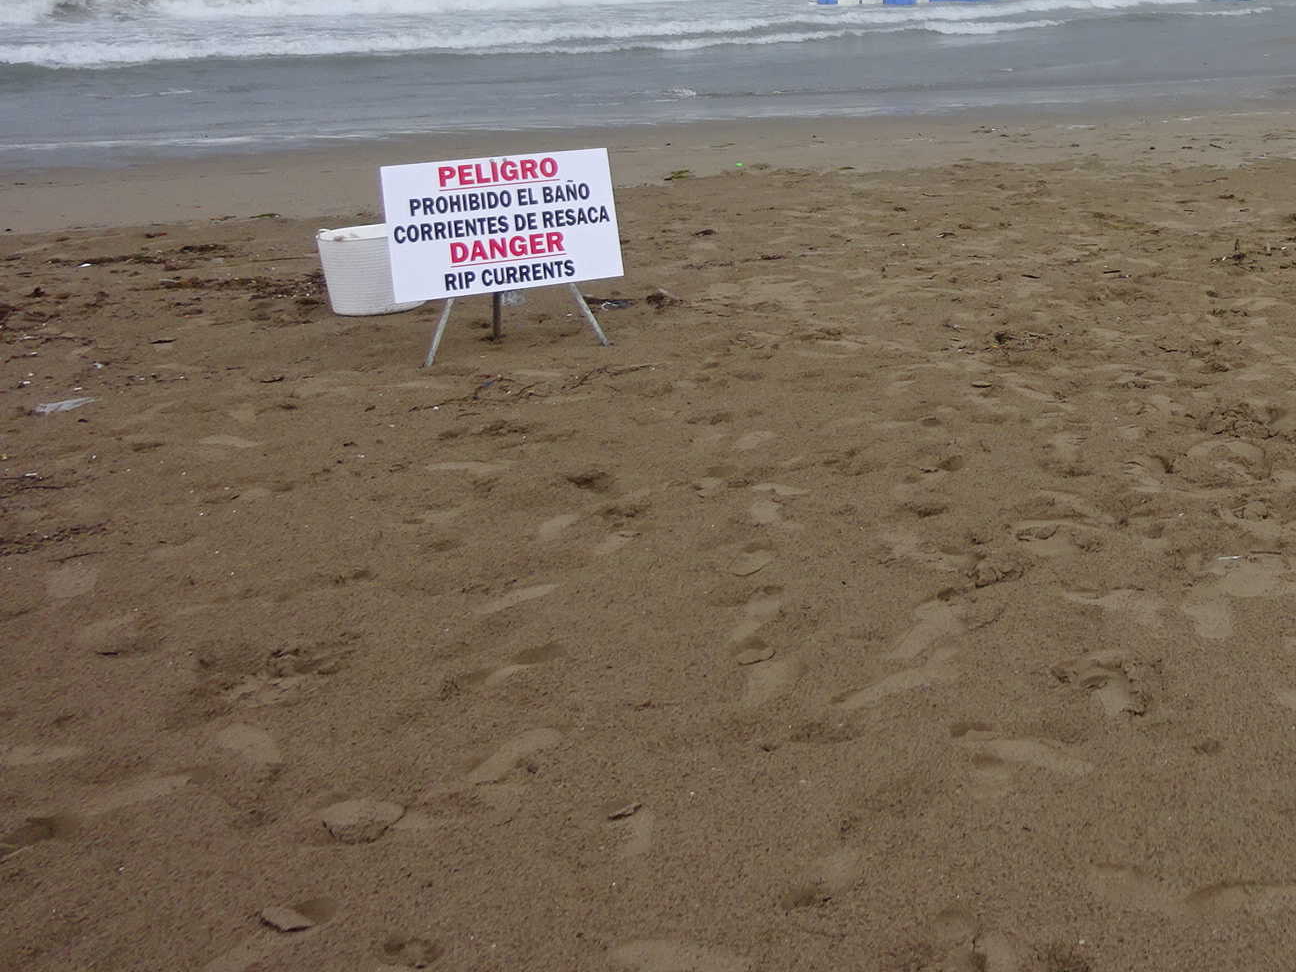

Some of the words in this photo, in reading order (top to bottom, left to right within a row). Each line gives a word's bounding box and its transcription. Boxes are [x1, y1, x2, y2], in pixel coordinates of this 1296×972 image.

[438, 157, 559, 188] PELIGRO
[409, 189, 512, 217] PROHIBIDO
[517, 188, 538, 206] EL
[543, 180, 590, 203] BAÑO
[393, 215, 509, 244] CORRIENTES
[514, 213, 537, 232] DE
[542, 205, 610, 229] RESACA
[449, 231, 566, 264] DANGER
[444, 271, 476, 291] RIP
[481, 259, 576, 287] CURRENTS
